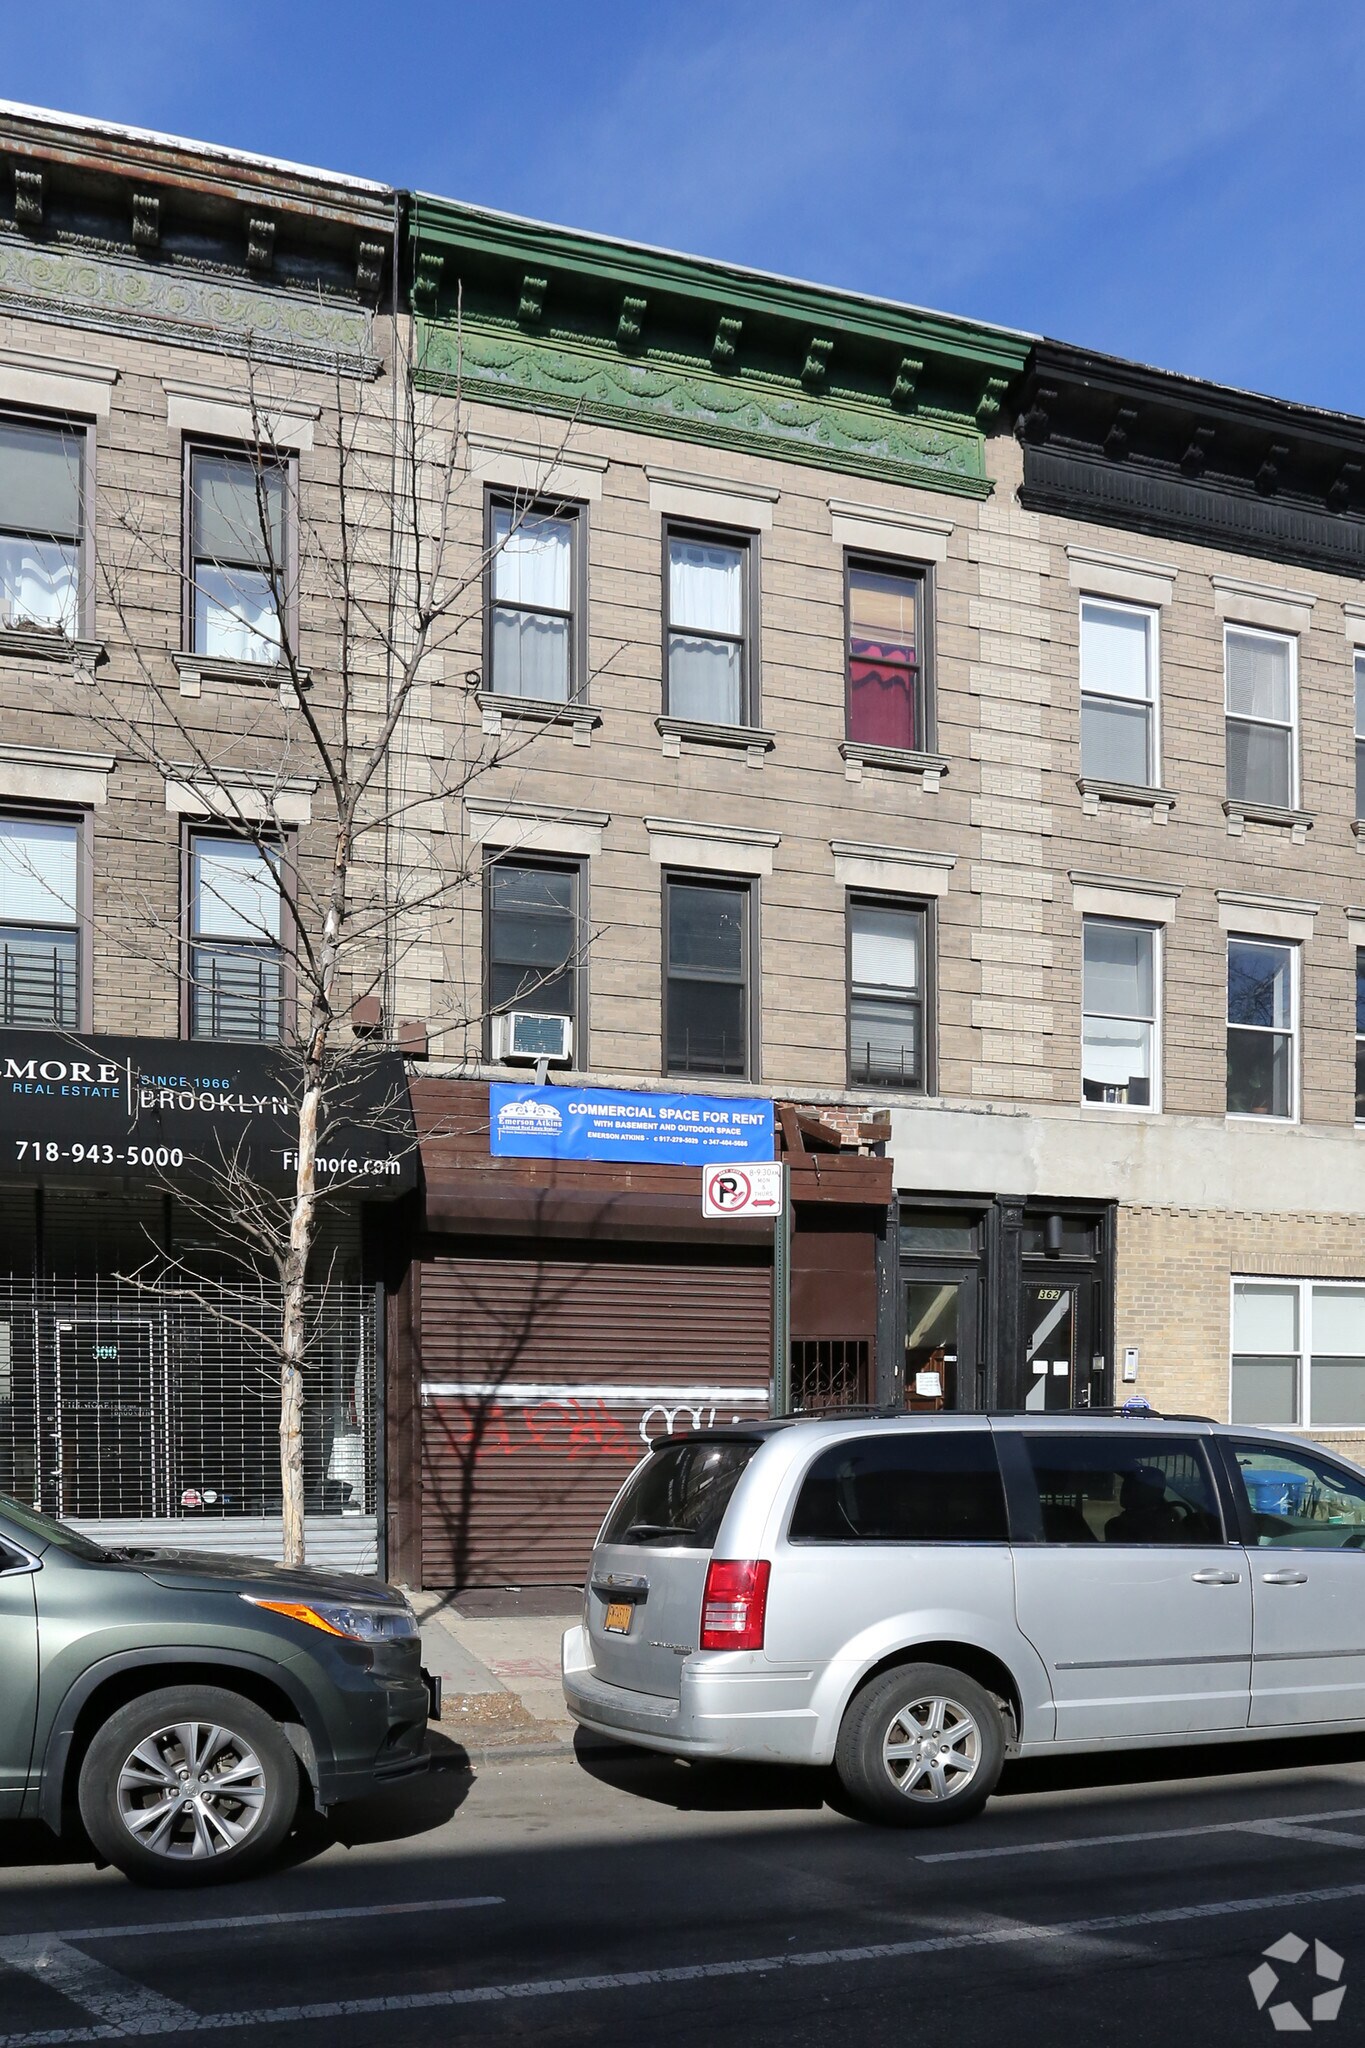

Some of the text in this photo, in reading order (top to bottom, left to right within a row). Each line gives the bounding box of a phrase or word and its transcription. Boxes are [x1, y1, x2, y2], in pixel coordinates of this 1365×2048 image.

[0, 1059, 120, 1084] MORE
[141, 1075, 230, 1089] SINCE 1966
[13, 1083, 120, 1098] REAL ESTATE
[140, 1089, 289, 1116] BROOKLYN
[498, 1117, 563, 1127] Emerson Atkins
[568, 1103, 765, 1125] COMMERCIAL SPACE FOR RENT
[593, 1119, 742, 1135] WITH BASEMENT AND OUTDOOR SPACE
[587, 1131, 620, 1140] EMERSON
[15, 1140, 183, 1167] 718-943-5000
[283, 1152, 401, 1175] Fimore.com
[1039, 1289, 1060, 1299] 362
